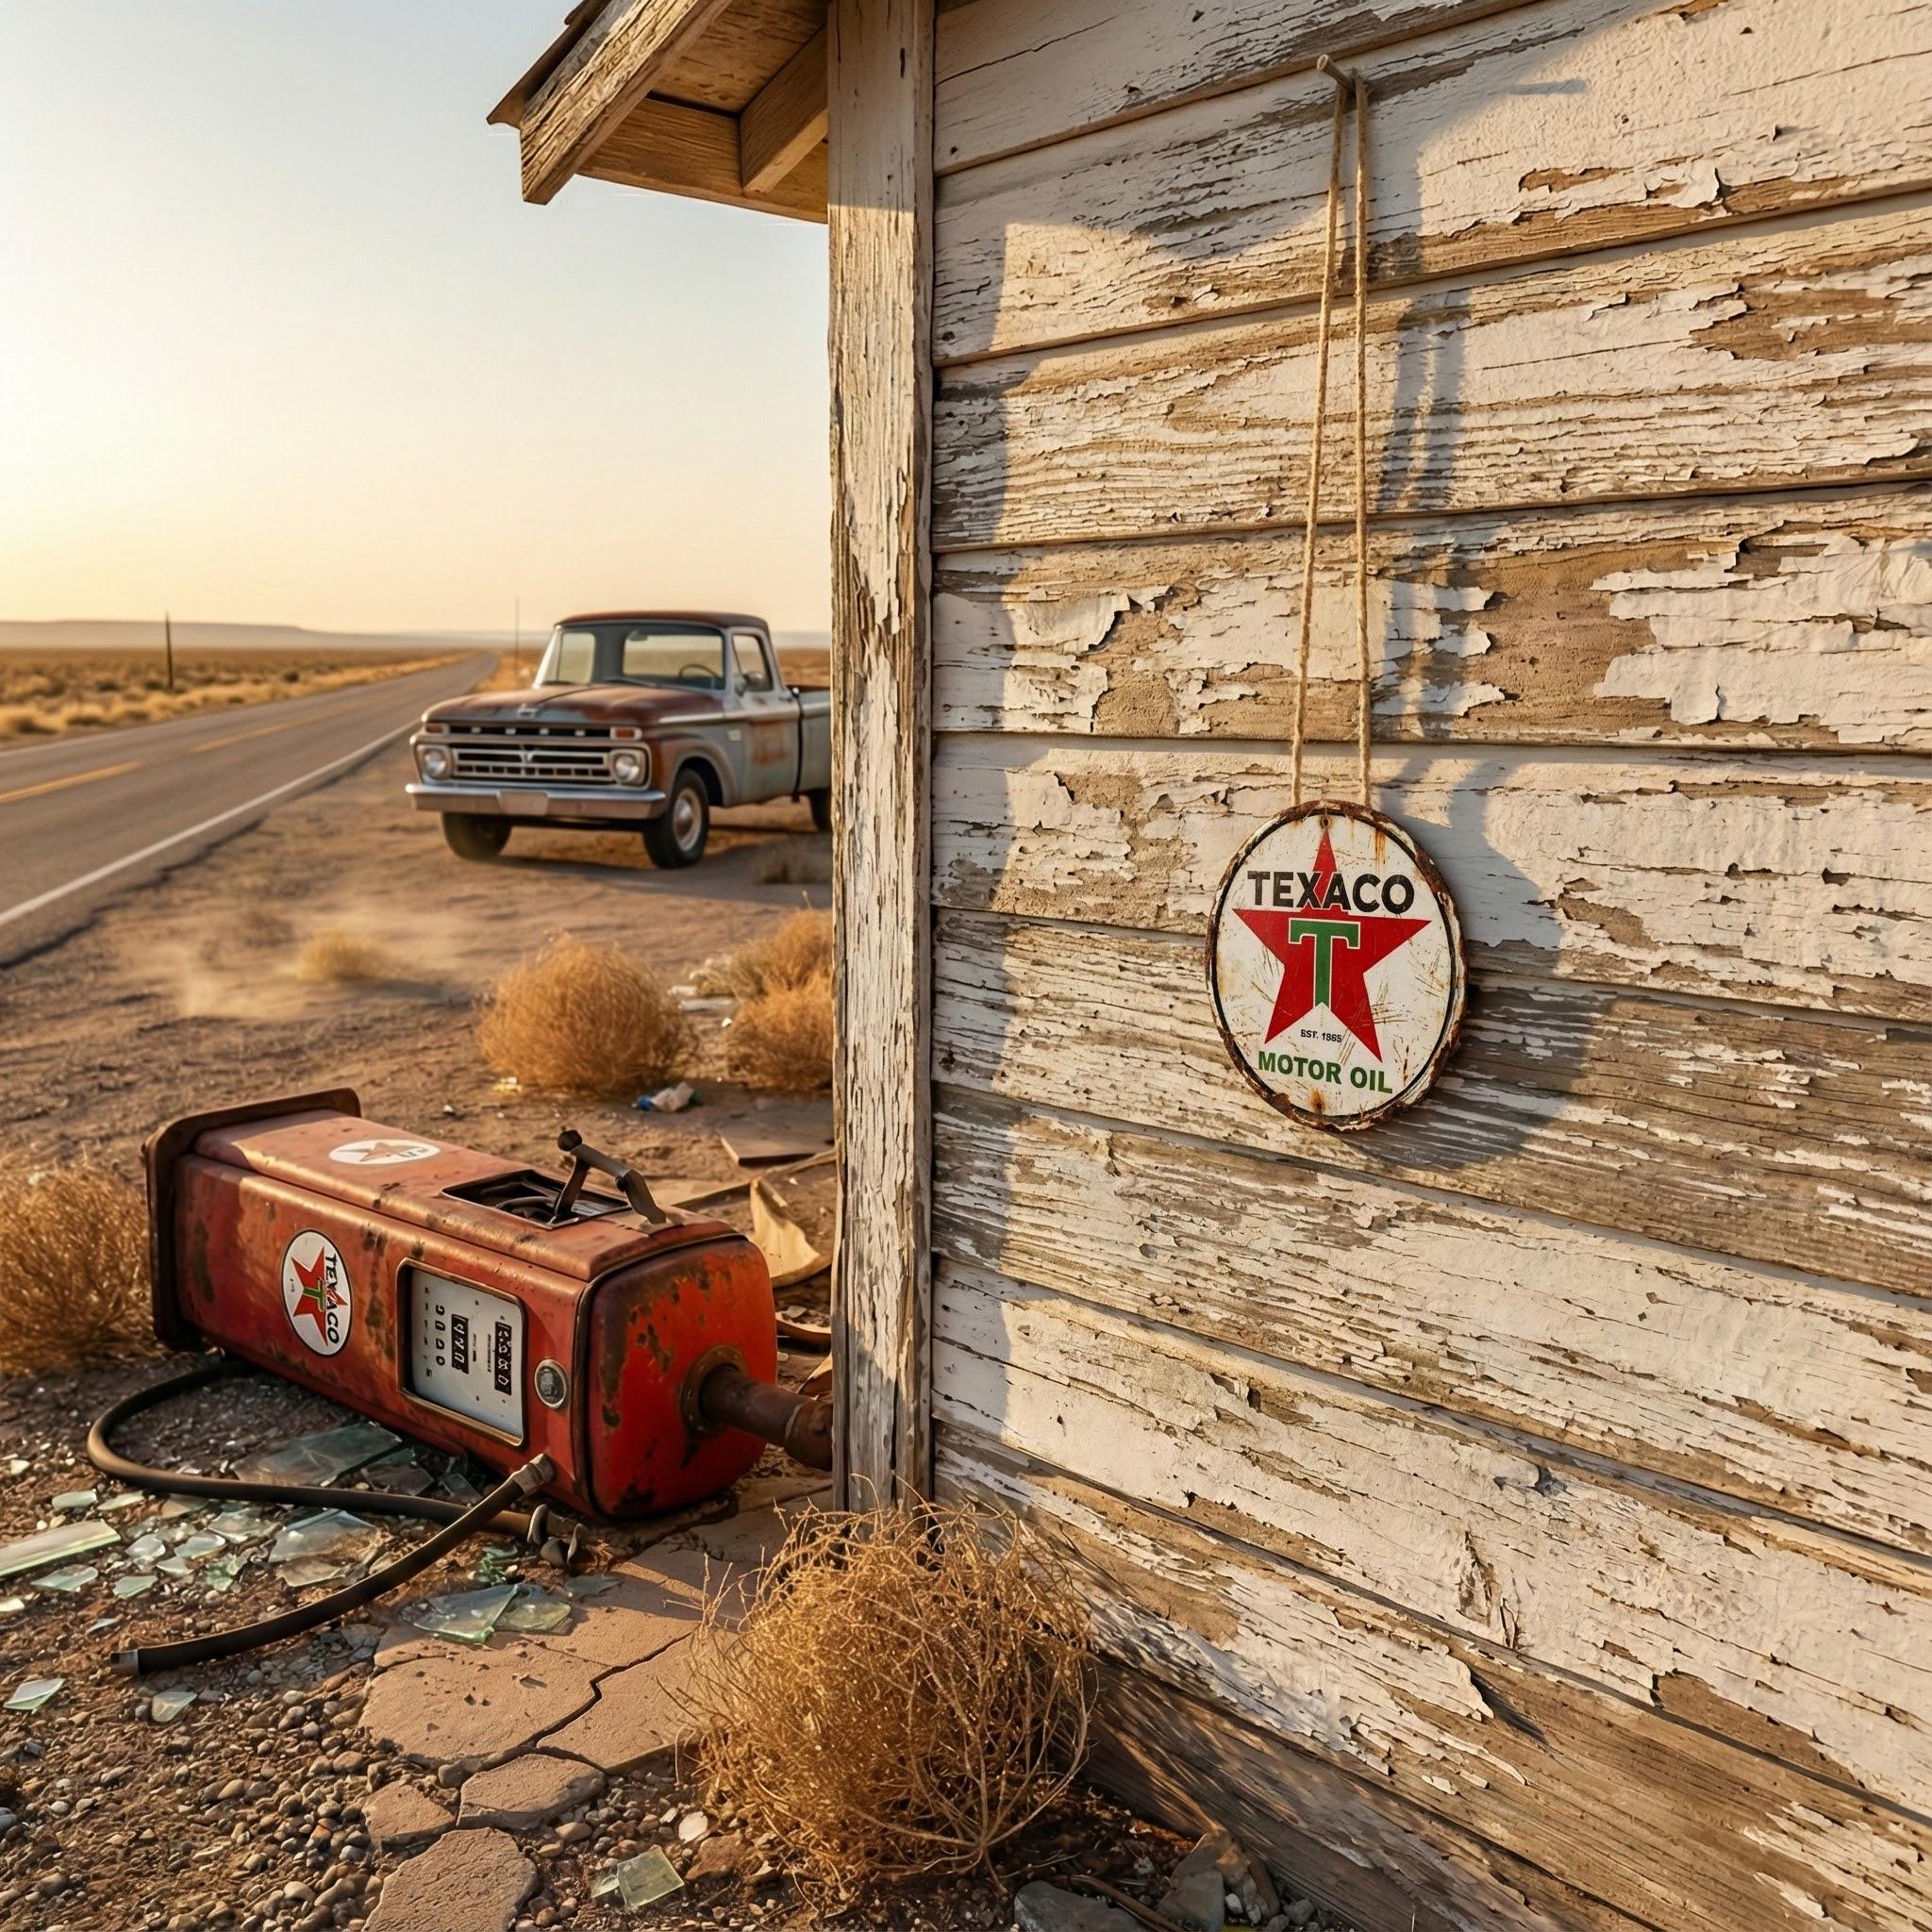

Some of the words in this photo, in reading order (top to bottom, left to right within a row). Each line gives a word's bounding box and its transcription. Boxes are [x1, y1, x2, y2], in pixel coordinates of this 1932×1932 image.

[1247, 871, 1415, 915] TEXACO
[1289, 918, 1360, 1011] T
[1257, 1050, 1341, 1085] MOTOR
[1350, 1067, 1393, 1094] OIL
[325, 1253, 340, 1345] TEXACO
